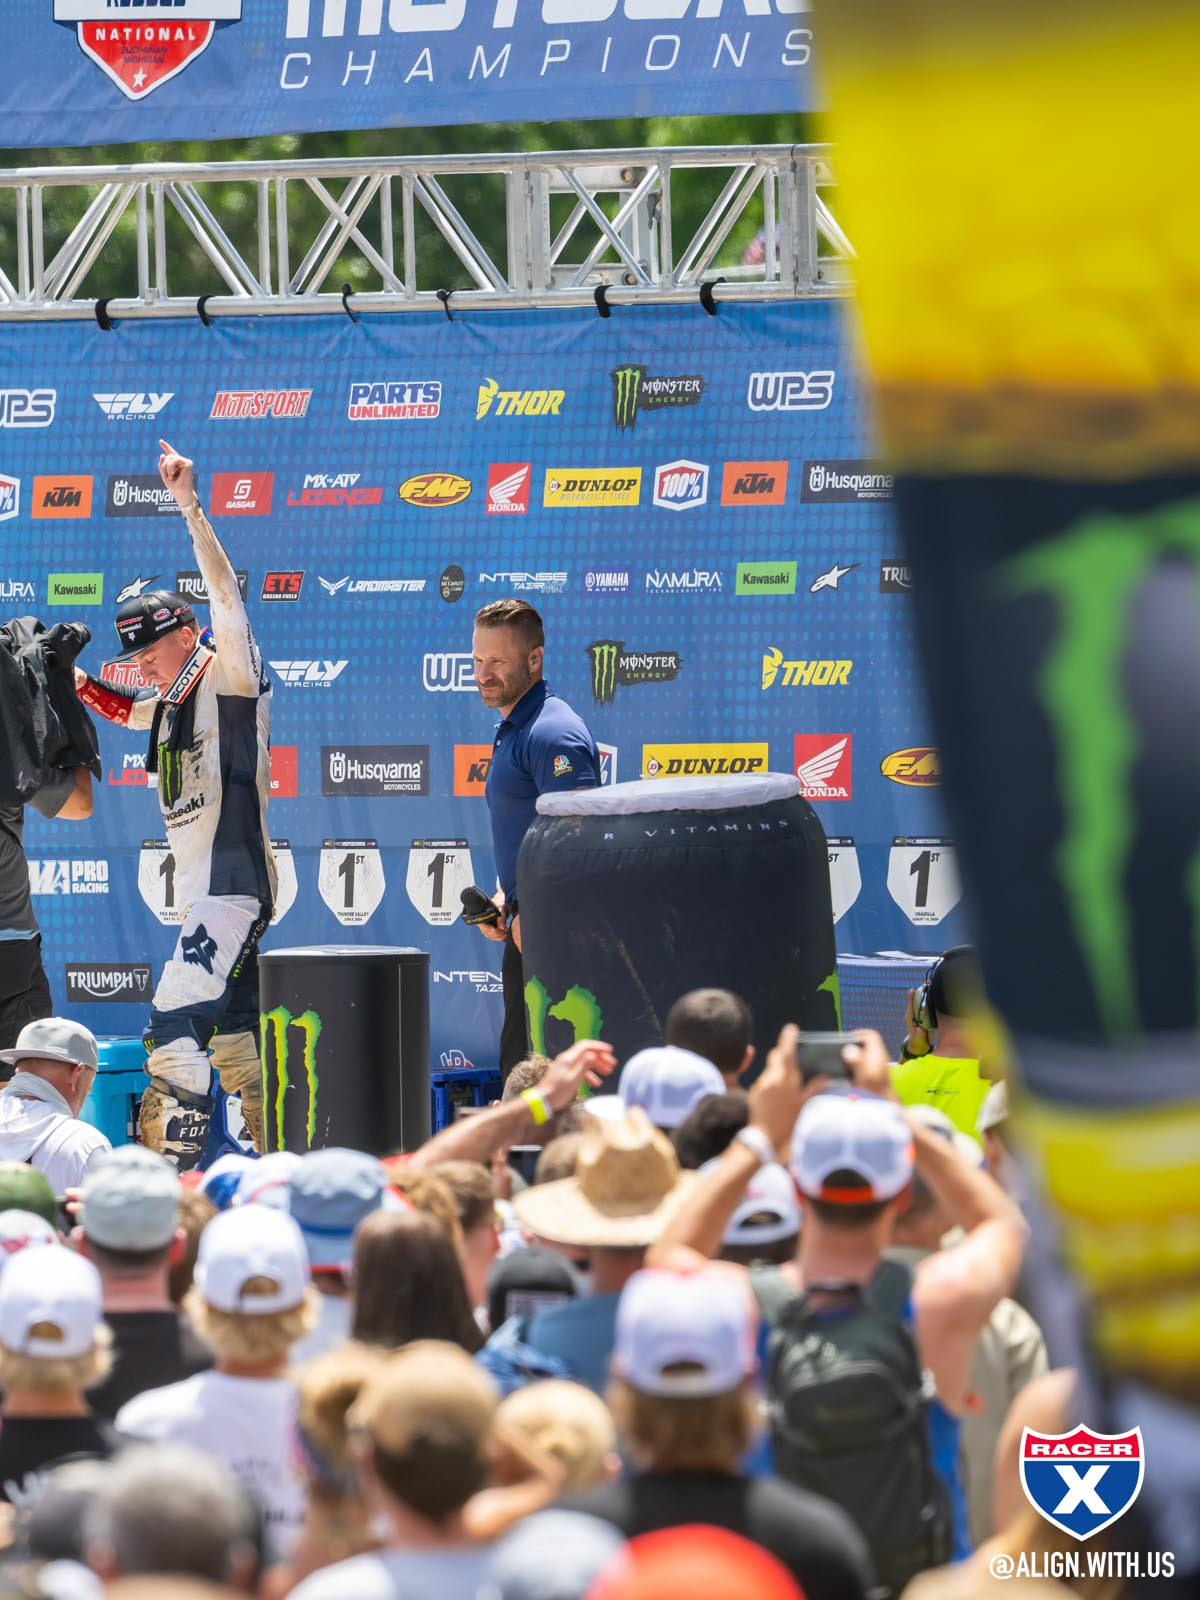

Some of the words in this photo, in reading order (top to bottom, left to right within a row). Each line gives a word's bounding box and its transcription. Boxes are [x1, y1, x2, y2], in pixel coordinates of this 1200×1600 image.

[95, 27, 196, 41] NATIONAL
[123, 56, 165, 64] MICHIGAN
[279, 28, 814, 89] CHAMPIONS
[350, 381, 440, 405] PARTS
[642, 378, 700, 394] MONSTER
[748, 370, 835, 411] WPS
[93, 392, 175, 414] FLY
[349, 403, 440, 419] UNLIMITED
[495, 390, 565, 415] THOR
[303, 474, 327, 488] MX
[331, 473, 361, 488] ATV
[400, 478, 471, 498] FMF
[562, 479, 637, 492] DUNLOP
[660, 473, 702, 498] 100%
[733, 473, 776, 494] KTM
[42, 487, 82, 507] KTM
[128, 486, 176, 505] Husqvar
[225, 501, 256, 509] GASGAS
[488, 503, 526, 512] HONDA
[264, 571, 304, 593] ETS
[347, 580, 426, 592] LANDMASTER
[479, 572, 567, 582] INTENSE
[594, 572, 629, 587] YAMAHA
[645, 568, 722, 588] NAMURA
[742, 571, 790, 585] Kawasaki
[882, 567, 912, 587] TRIU
[54, 584, 97, 595] Kawasaki
[178, 578, 210, 599] TRIU
[268, 660, 349, 681] FLY
[619, 653, 677, 670] MONSTER
[170, 659, 200, 702] SCOTT
[423, 653, 479, 692] WP
[781, 660, 853, 686] THOR
[347, 760, 420, 782] Husqvarna
[467, 758, 491, 782] KT
[665, 758, 763, 774] DUNLOP
[883, 752, 941, 776] FM
[800, 787, 848, 797] HONDA
[603, 832, 614, 840] B
[644, 819, 788, 838] VITAMINS
[71, 860, 109, 882] PRO
[72, 882, 109, 894] RACING
[67, 971, 133, 996] TRIUMPH
[433, 971, 503, 982] INTEN
[475, 983, 503, 992] TAZE
[179, 1125, 207, 1138] FOX
